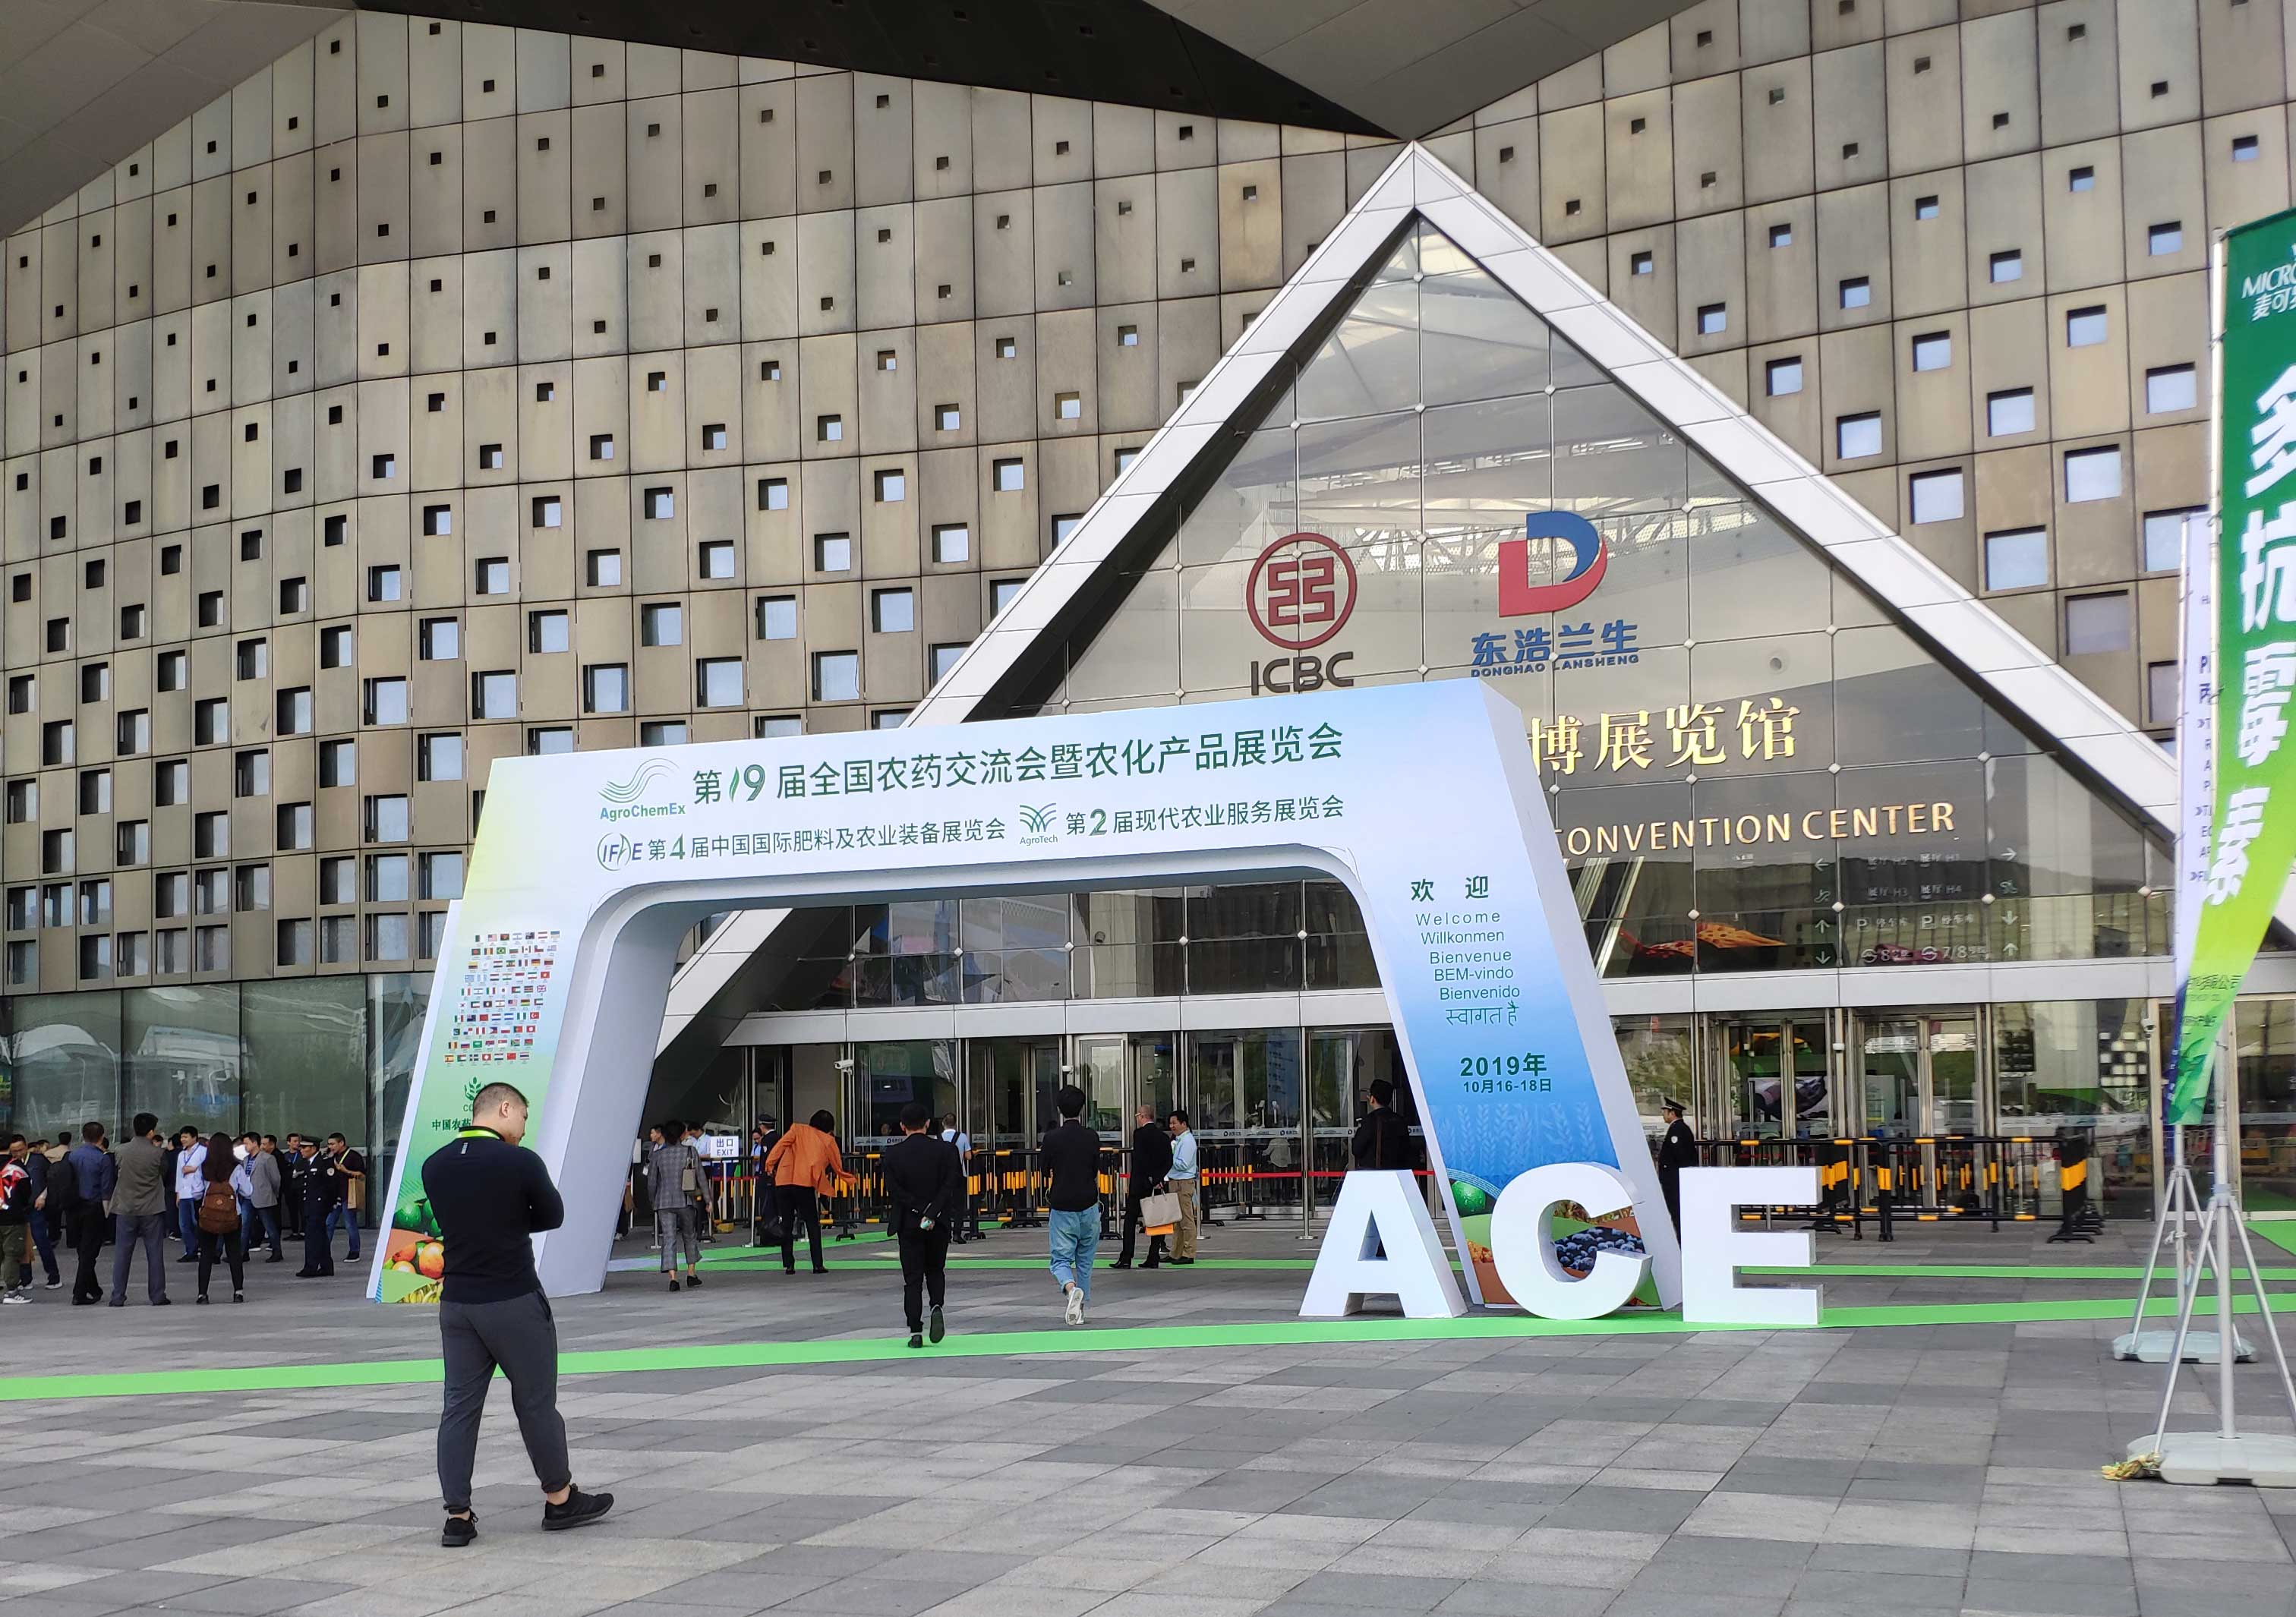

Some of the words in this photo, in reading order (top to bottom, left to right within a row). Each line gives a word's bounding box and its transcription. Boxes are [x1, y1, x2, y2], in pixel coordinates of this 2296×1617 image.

[1471, 619, 1639, 666] 东浩兰生
[1250, 651, 1355, 696] ICBC
[1471, 662, 1546, 679] DONGHAO
[1552, 654, 1639, 672] LANSHENG
[1527, 696, 1801, 777] 博展览馆
[600, 802, 686, 822] AgroChemEx
[1065, 794, 1344, 837] 第2届现代农业服务展览会
[1554, 812, 1791, 856] ONVENTION
[1802, 801, 1955, 840] CENTER
[1020, 834, 1058, 846] AgroTech
[1415, 911, 1501, 926] Welcome
[1421, 930, 1505, 945] Willkonmen
[1430, 950, 1512, 964] Bienvenue
[1434, 966, 1514, 982] BEM-vindo
[1440, 985, 1520, 1001] Bienvenido
[1445, 1007, 1503, 1026] स्वागत
[1505, 1001, 1519, 1026] है
[1460, 1052, 1547, 1077] 2019年
[1464, 1079, 1552, 1093] 10月16-18日
[716, 1138, 733, 1147] 出口
[1299, 1162, 1823, 1326] ACE
